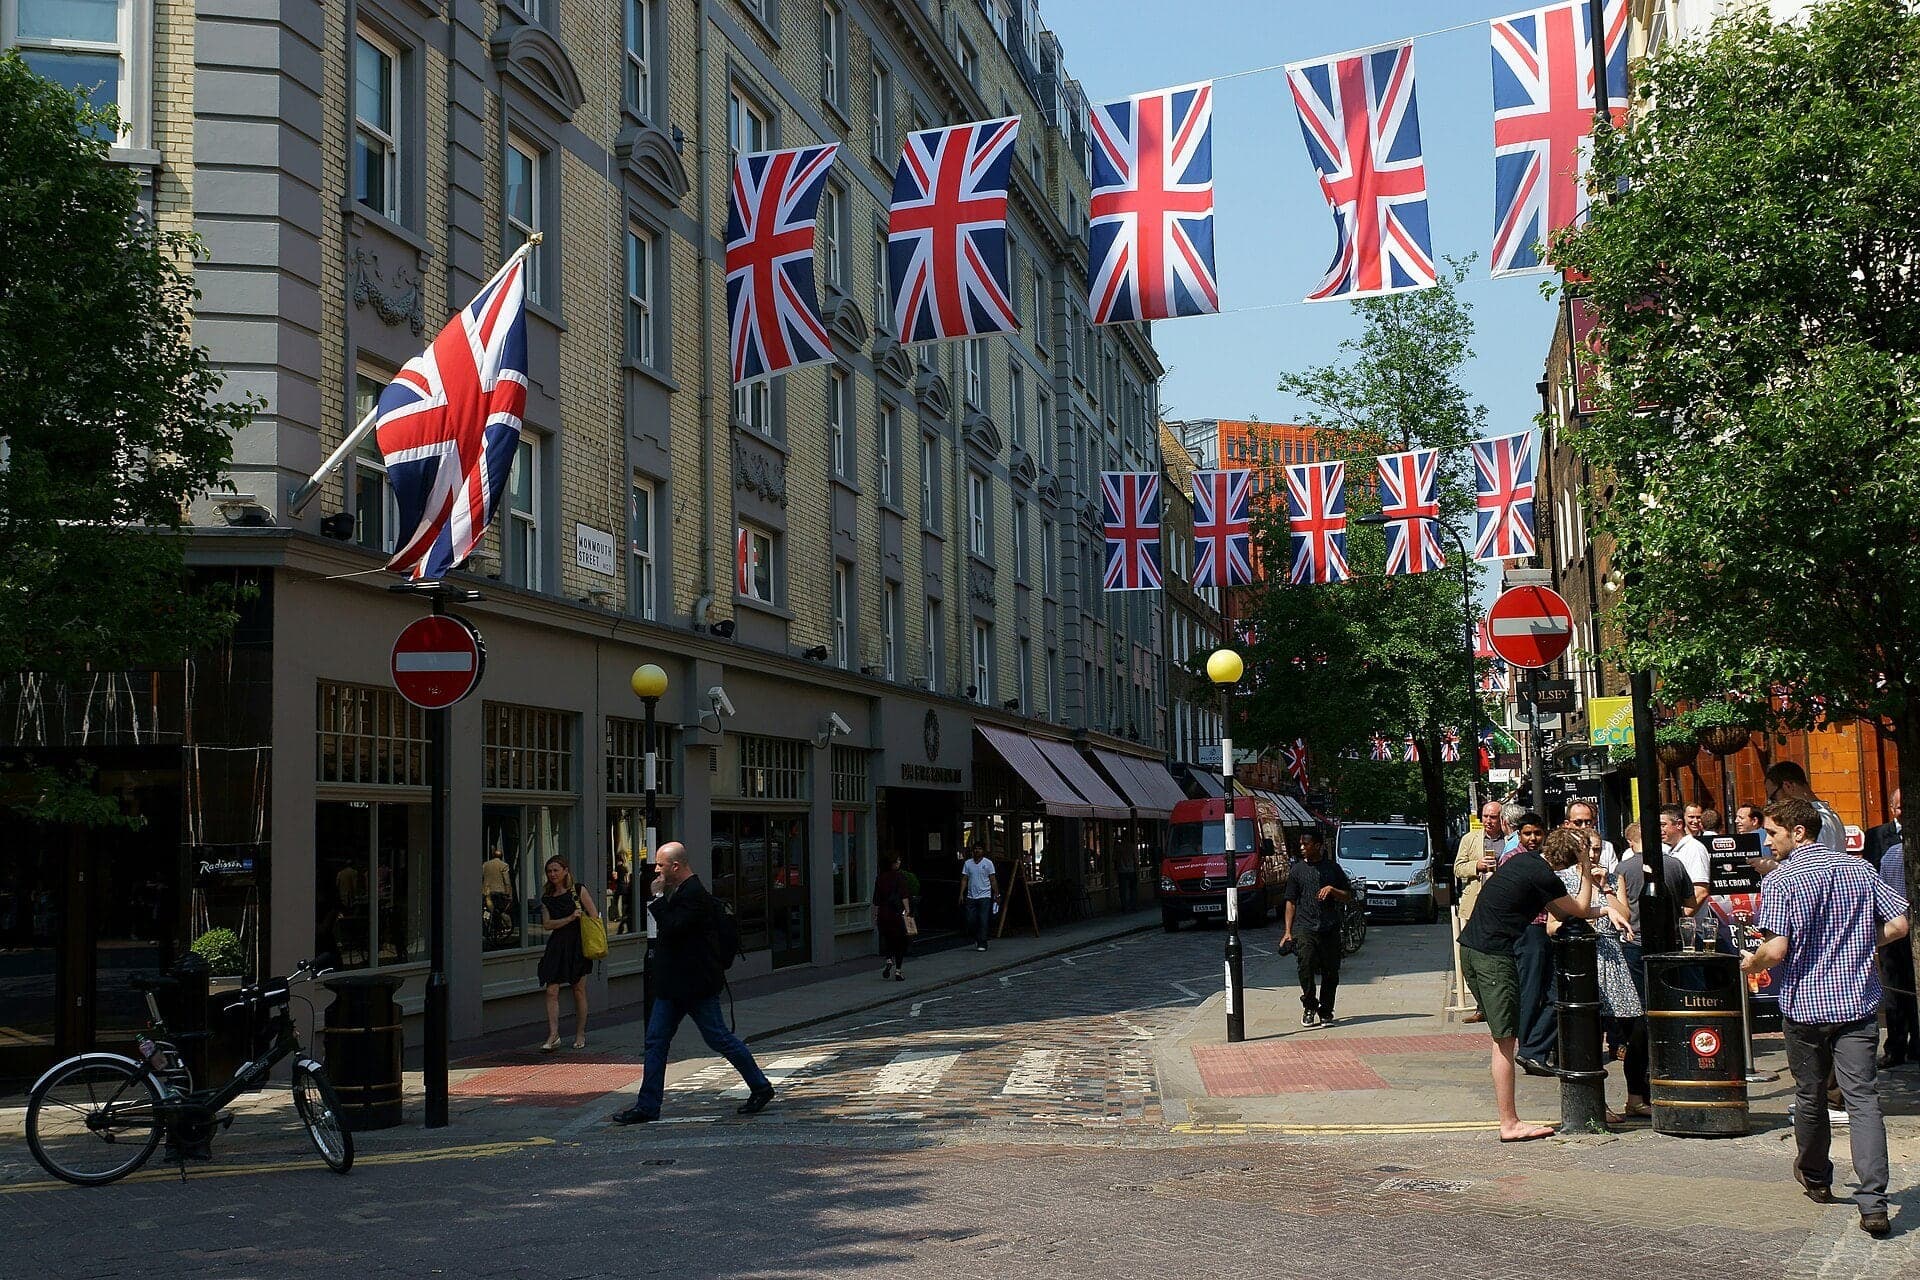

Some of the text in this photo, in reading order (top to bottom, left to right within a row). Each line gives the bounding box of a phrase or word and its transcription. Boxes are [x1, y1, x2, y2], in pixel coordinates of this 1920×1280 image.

[578, 536, 612, 557] MONMOUTH
[578, 550, 599, 567] STREET
[199, 858, 243, 875] Radisson
[1713, 878, 1751, 888] THE CROWN
[1684, 995, 1719, 1007] Litter
